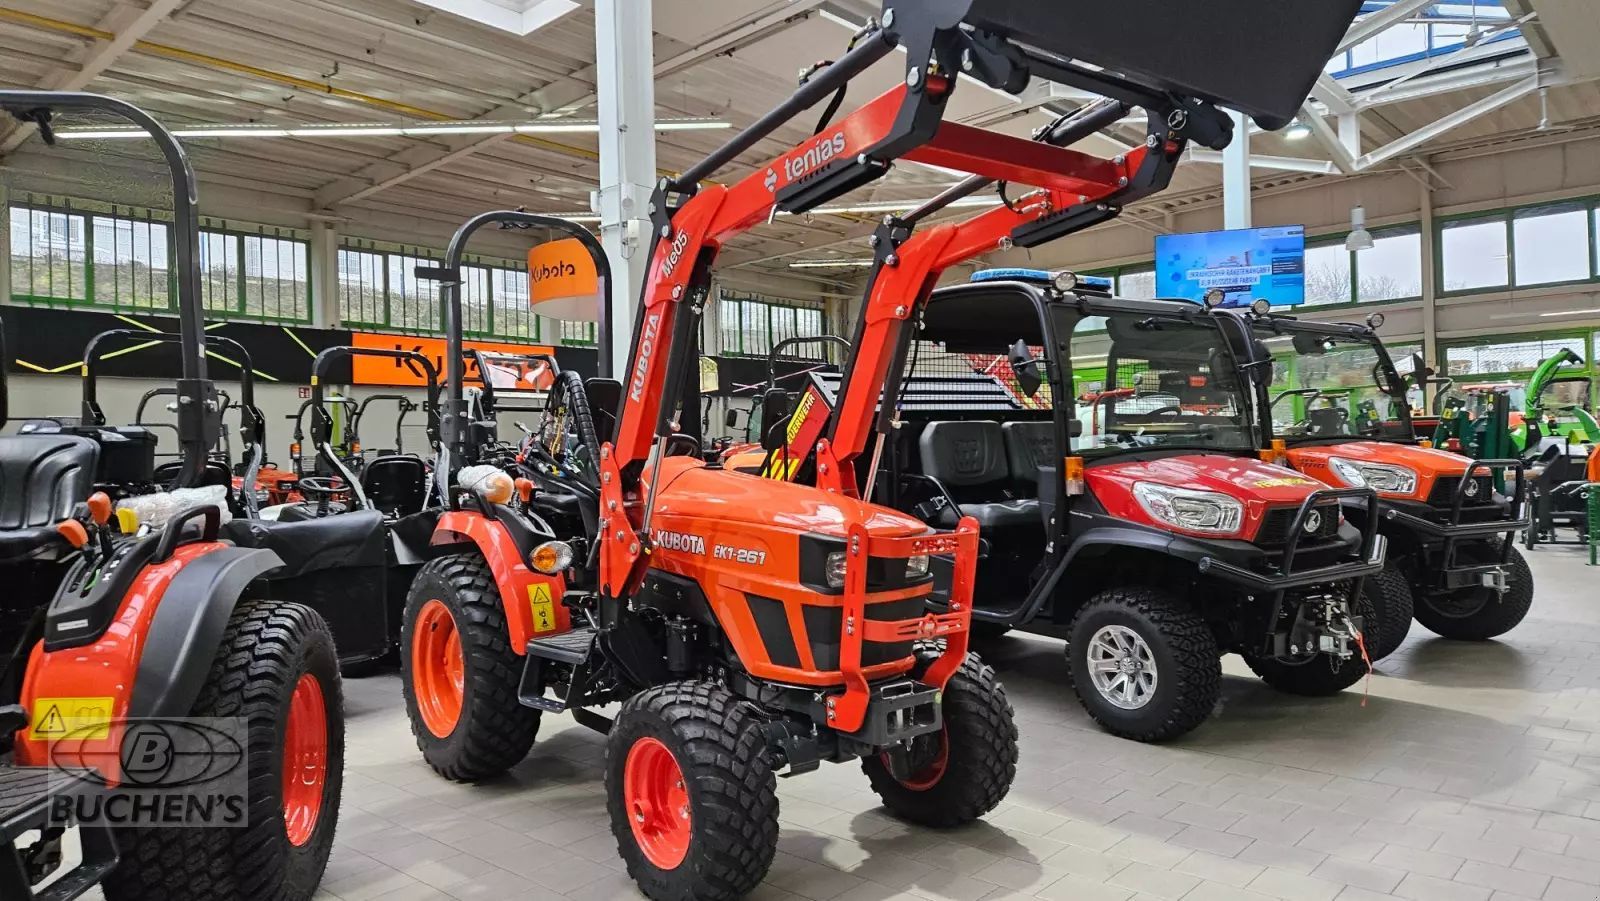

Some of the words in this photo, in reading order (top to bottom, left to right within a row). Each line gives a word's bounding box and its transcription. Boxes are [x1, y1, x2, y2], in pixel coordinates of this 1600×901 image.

[784, 131, 846, 182] tenias
[531, 260, 576, 283] Kubota
[662, 229, 688, 278] Me05
[631, 314, 660, 402] KUBOTA
[787, 394, 816, 445] EUERWEHR
[657, 530, 706, 556] KUBOTA
[714, 544, 767, 566] EK1-261
